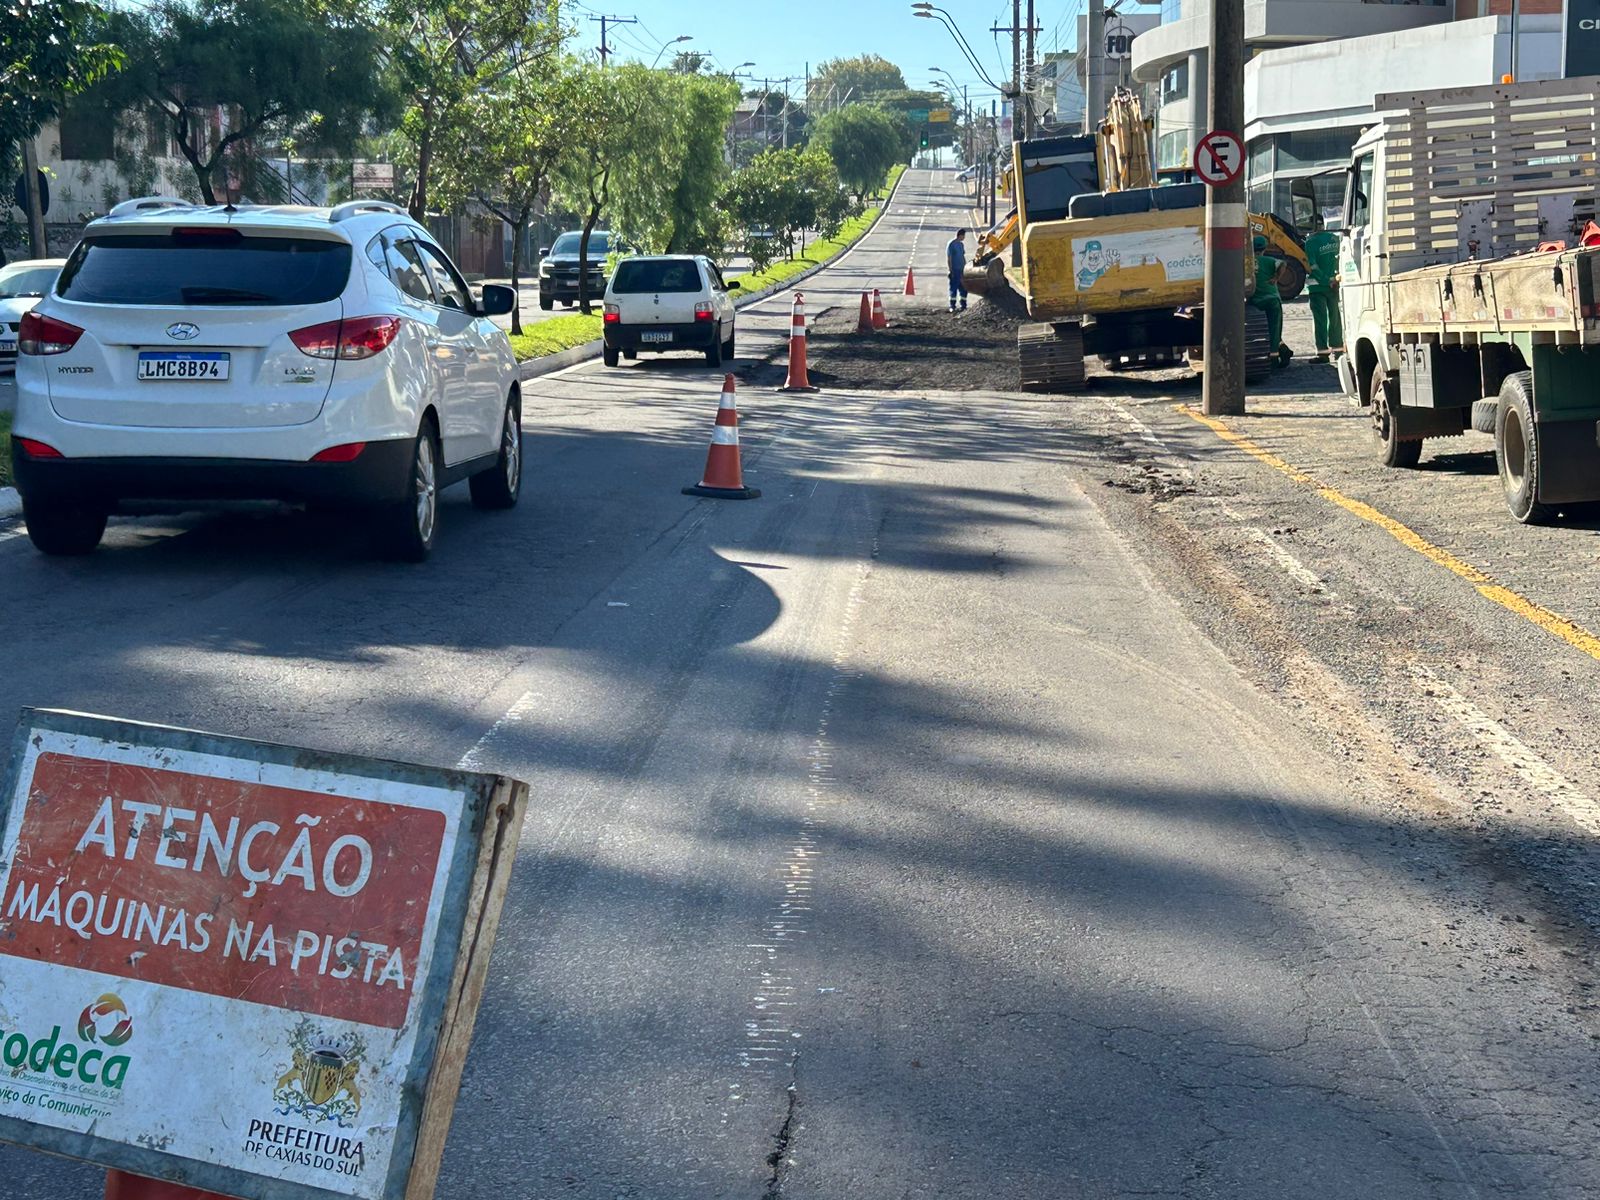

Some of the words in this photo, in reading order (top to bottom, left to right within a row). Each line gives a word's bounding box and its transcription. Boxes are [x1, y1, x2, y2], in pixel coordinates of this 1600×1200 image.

[1210, 142, 1230, 174] E
[145, 361, 219, 377] LMC8B94
[75, 796, 374, 898] ATENÇÃO
[7, 876, 214, 953] MÁQUINAS
[223, 917, 277, 967] NA
[290, 929, 406, 990] PISTA
[0, 1025, 132, 1090] odeca
[22, 1090, 36, 1105] da
[248, 1119, 364, 1160] PREFEITURA
[265, 1144, 312, 1166] CAXIAS
[313, 1155, 335, 1171] DO
[336, 1160, 360, 1178] SUL
